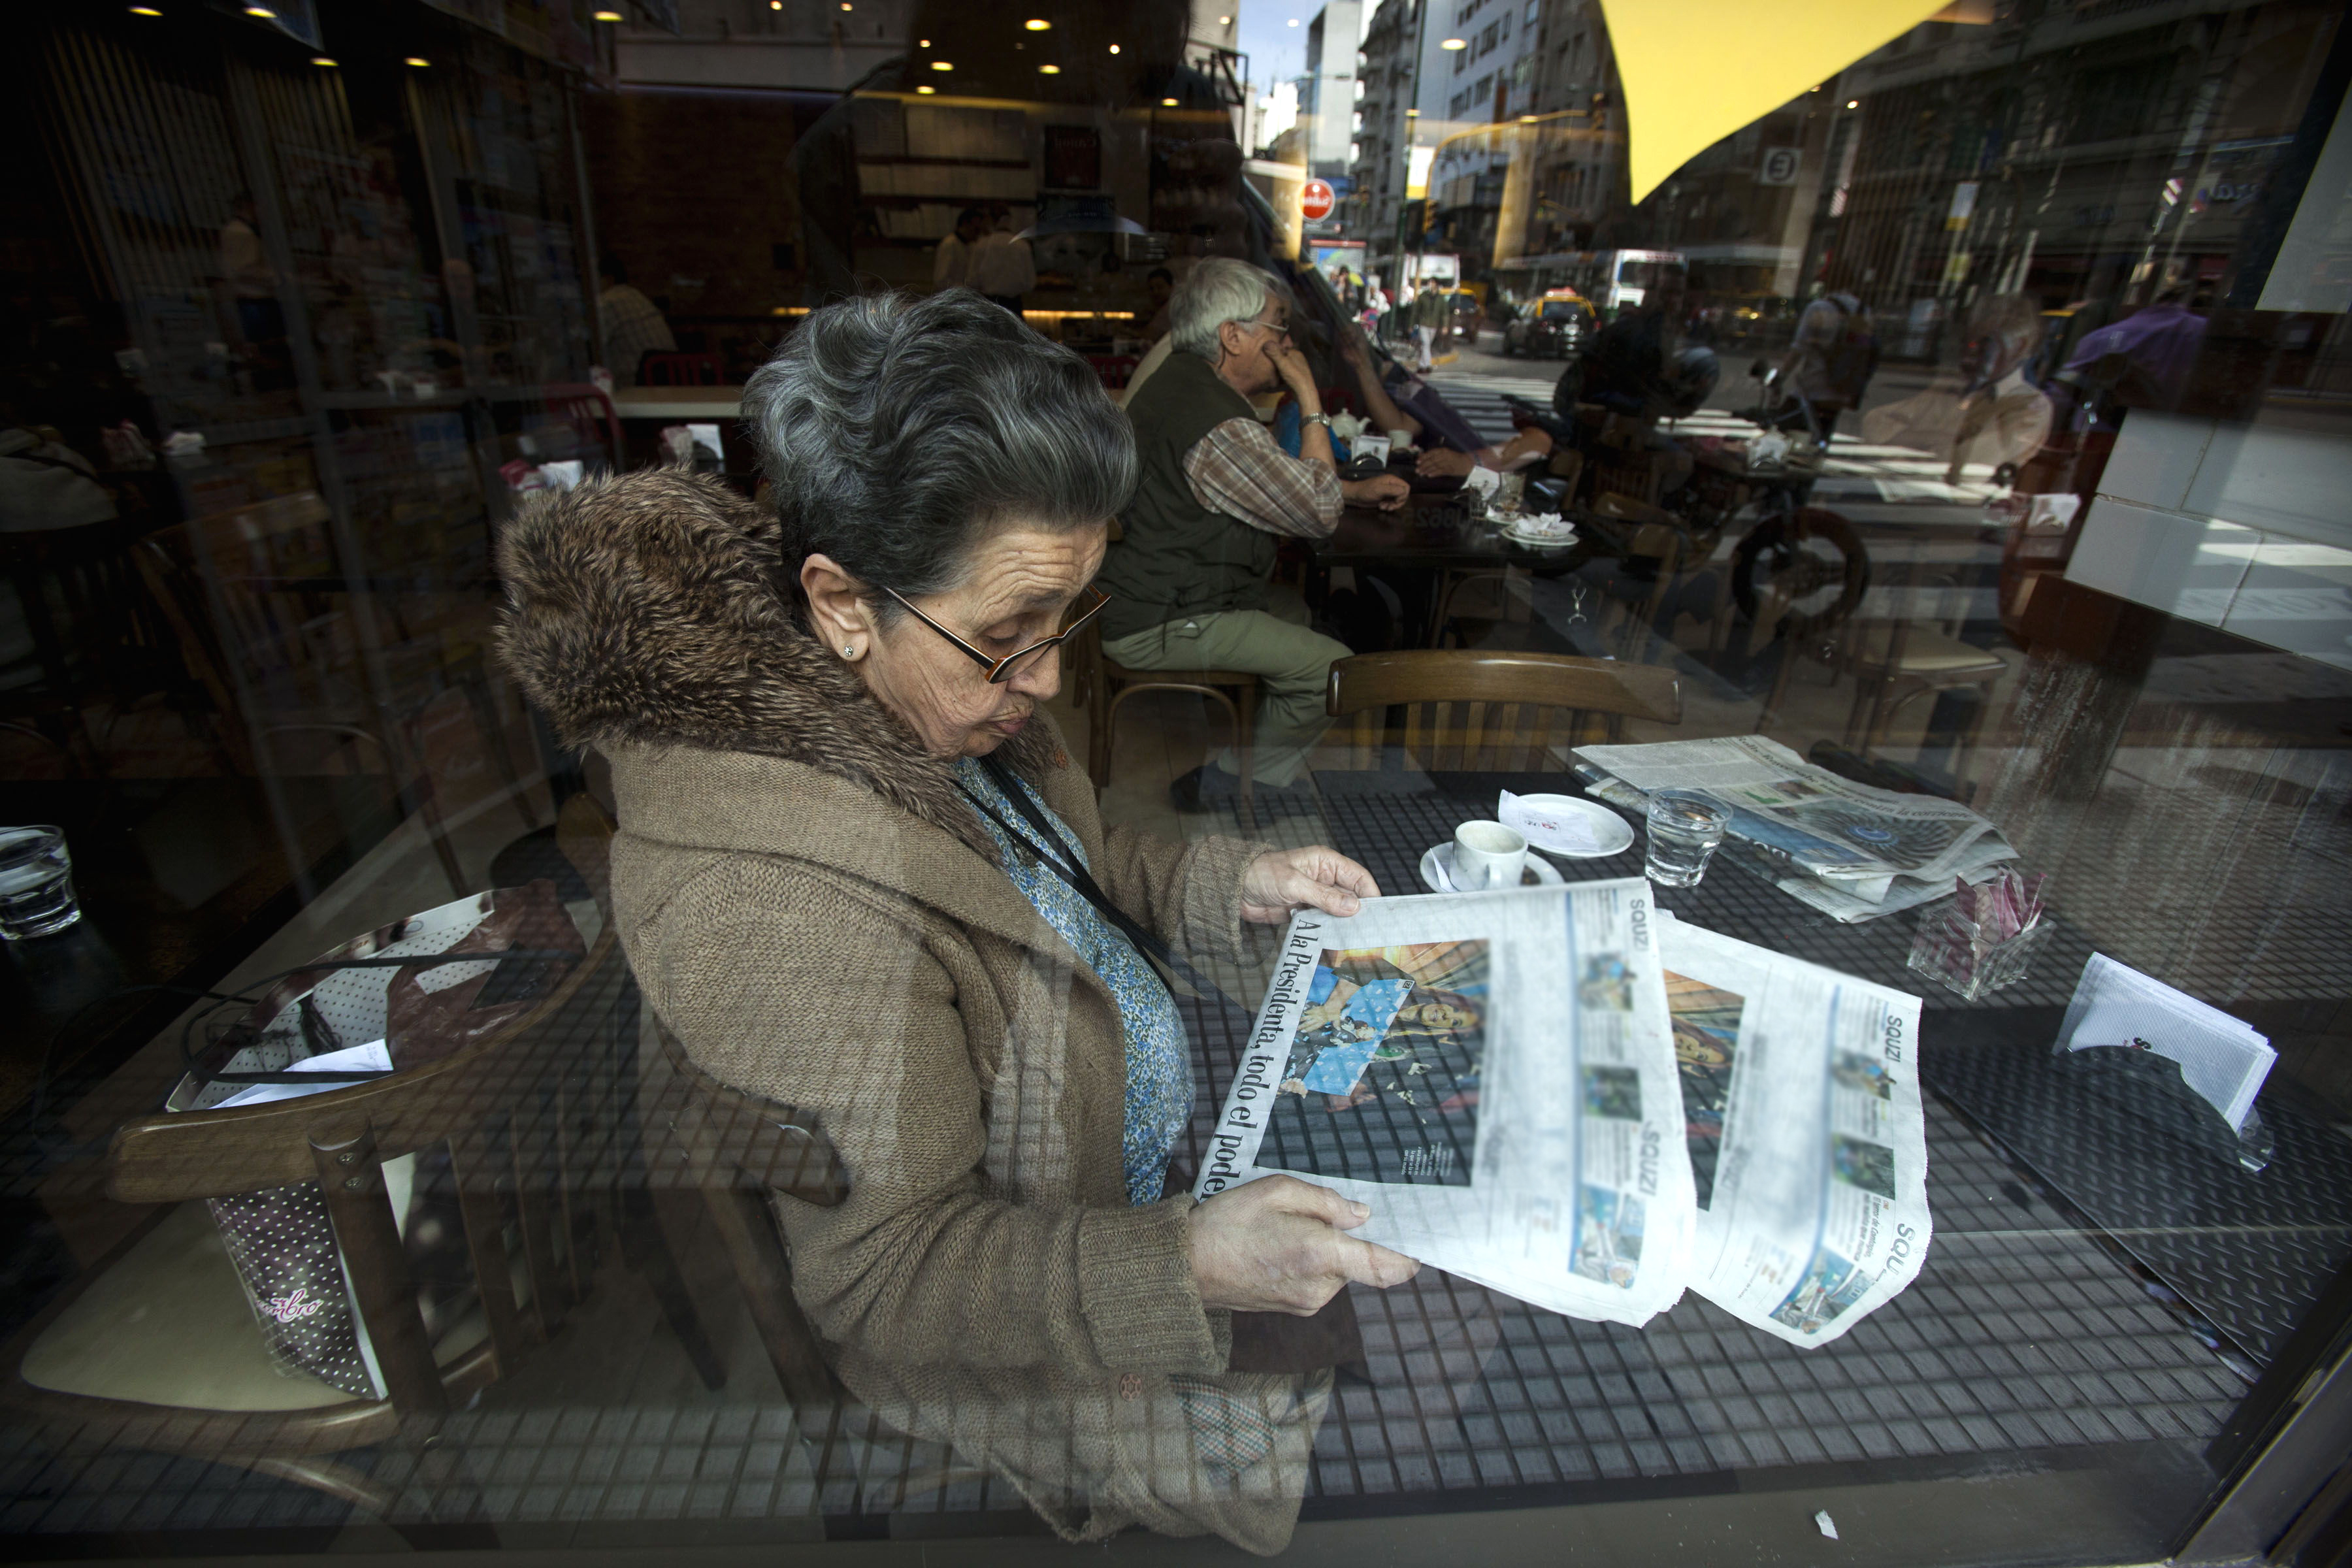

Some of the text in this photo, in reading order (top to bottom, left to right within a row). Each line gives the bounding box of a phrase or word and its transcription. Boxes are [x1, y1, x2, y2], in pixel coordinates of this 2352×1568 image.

[1298, 919, 1322, 930] A
[1290, 931, 1318, 949] la
[1250, 952, 1313, 1049] Presidenta,
[1237, 1054, 1275, 1100] todo
[1227, 1107, 1258, 1129] el
[1872, 1218, 1880, 1228] de
